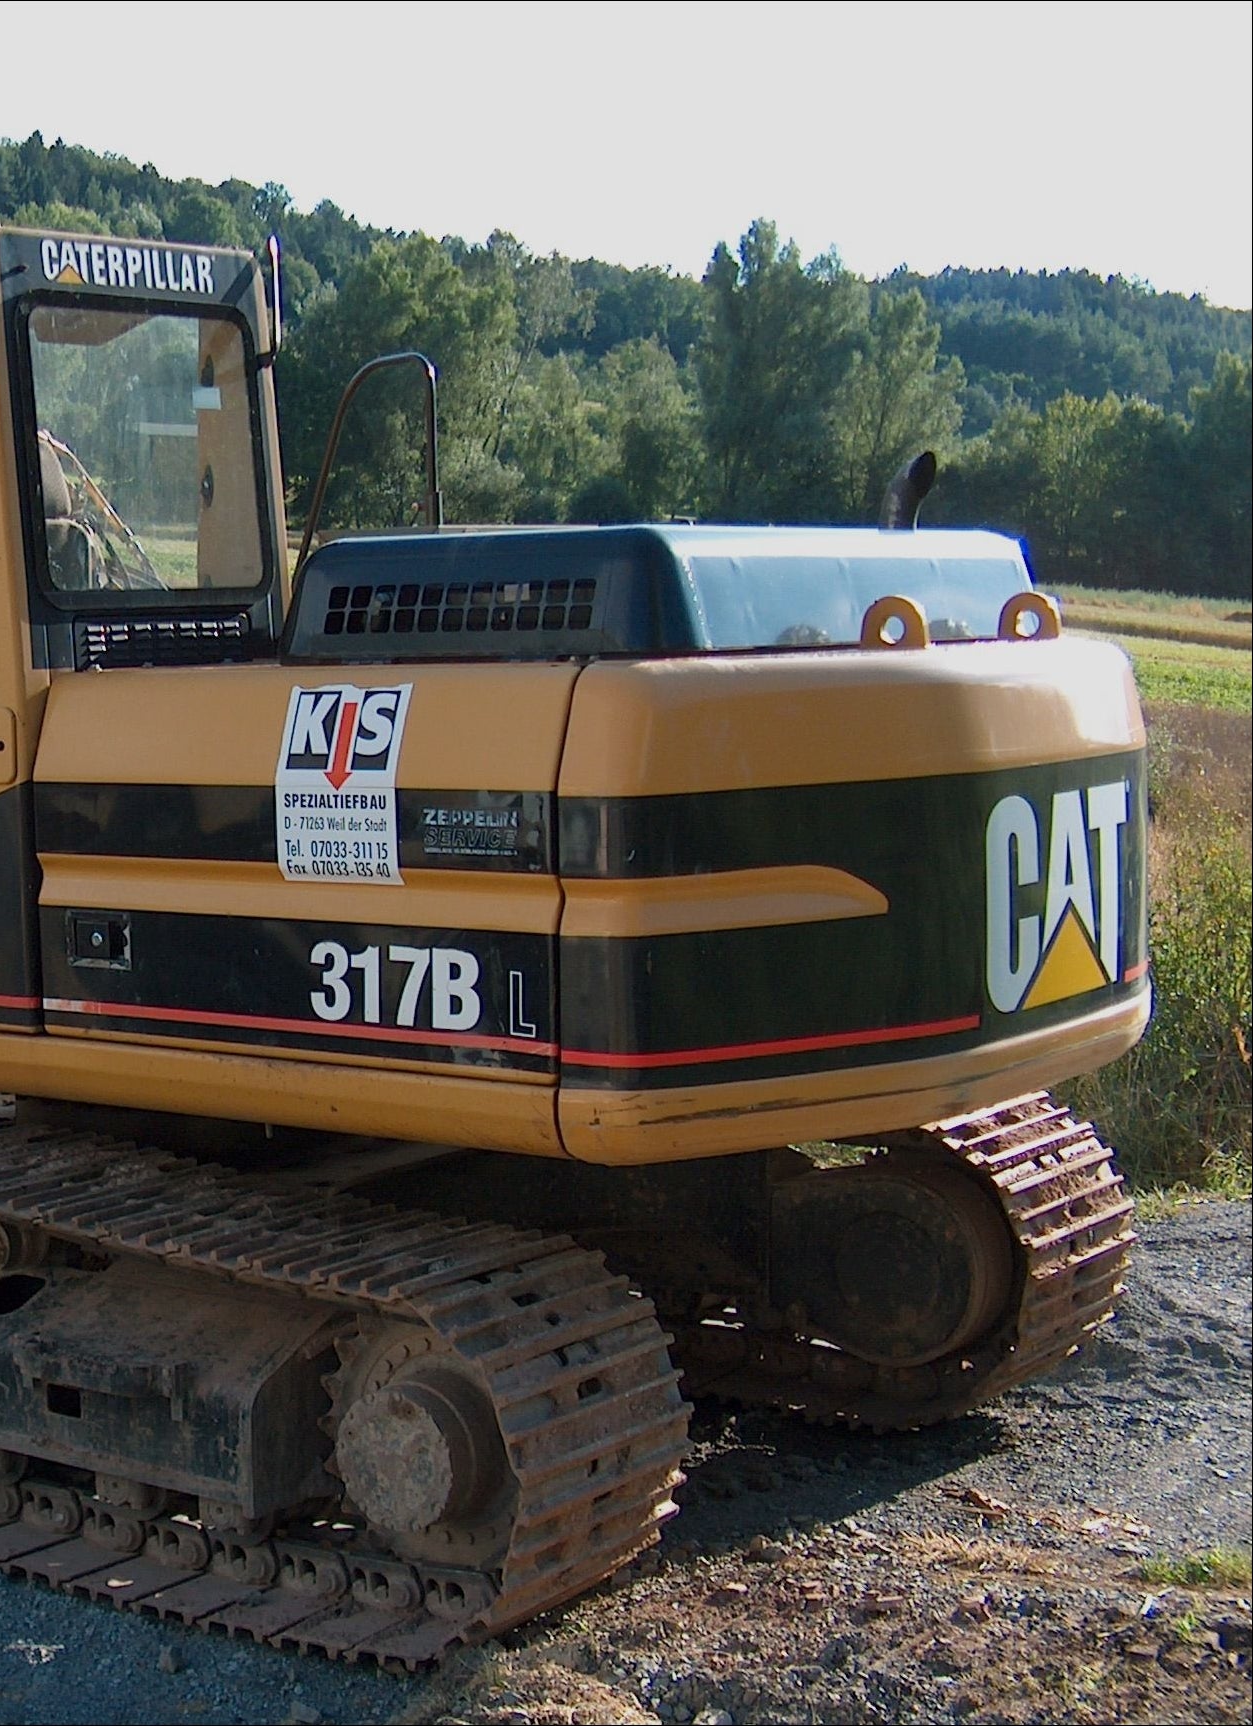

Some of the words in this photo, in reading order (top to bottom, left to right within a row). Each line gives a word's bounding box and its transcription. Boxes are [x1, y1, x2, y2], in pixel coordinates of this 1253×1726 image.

[41, 239, 214, 294] CATERPILLAR
[284, 793, 387, 810] SPEZIALTIEFBAU
[284, 816, 291, 830] D
[300, 816, 325, 831] 71263
[327, 816, 346, 831] Weil
[348, 816, 362, 832] der
[365, 817, 387, 832] Stadt
[422, 808, 519, 828] ZEPPELIN
[423, 827, 519, 848] SERVICE
[285, 839, 305, 857] Tel.
[286, 859, 307, 875] Fax
[985, 780, 1128, 1014] CAT
[309, 940, 481, 1032] 317B
[509, 970, 536, 1038] L
